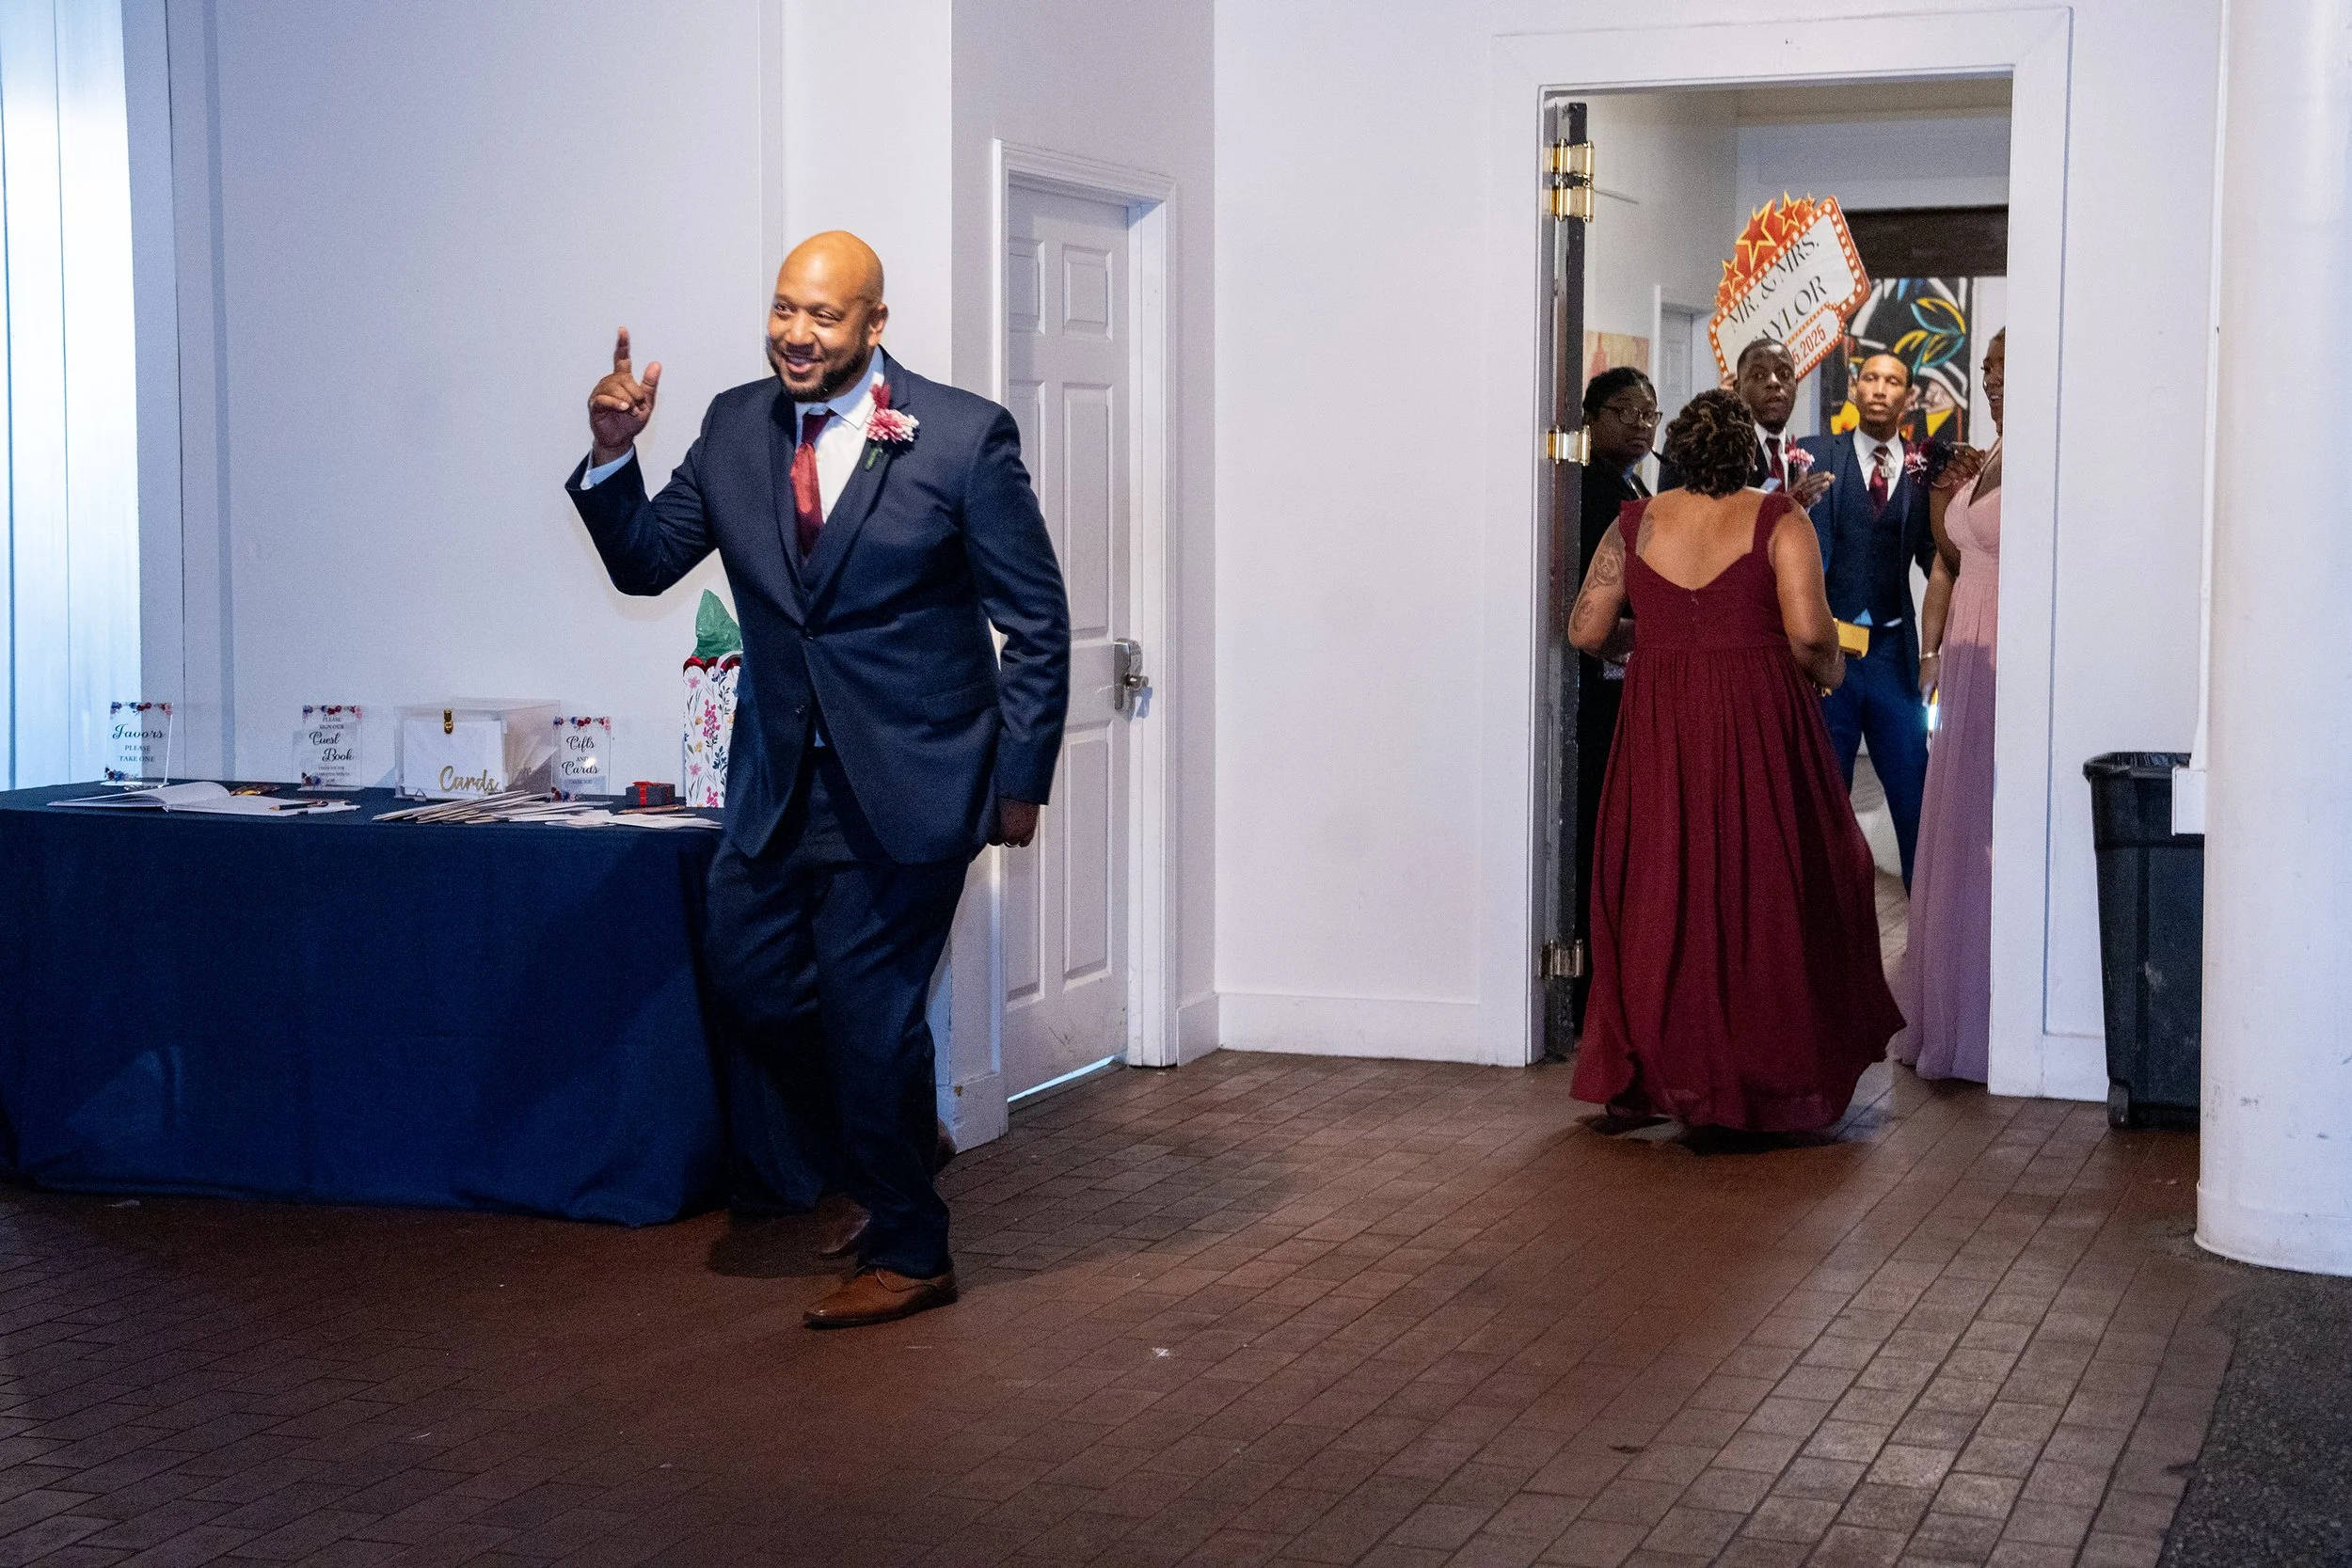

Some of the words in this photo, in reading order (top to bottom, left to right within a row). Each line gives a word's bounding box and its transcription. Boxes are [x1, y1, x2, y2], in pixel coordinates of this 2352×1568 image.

[1728, 295, 1759, 334] MR.
[1760, 276, 1777, 300] &
[1775, 231, 1820, 283] MRS.
[1755, 276, 1827, 341] AYLOR
[1791, 324, 1826, 365] 5.2025
[322, 748, 354, 762] Book
[562, 761, 599, 775] Cards
[439, 765, 500, 792] Cards
